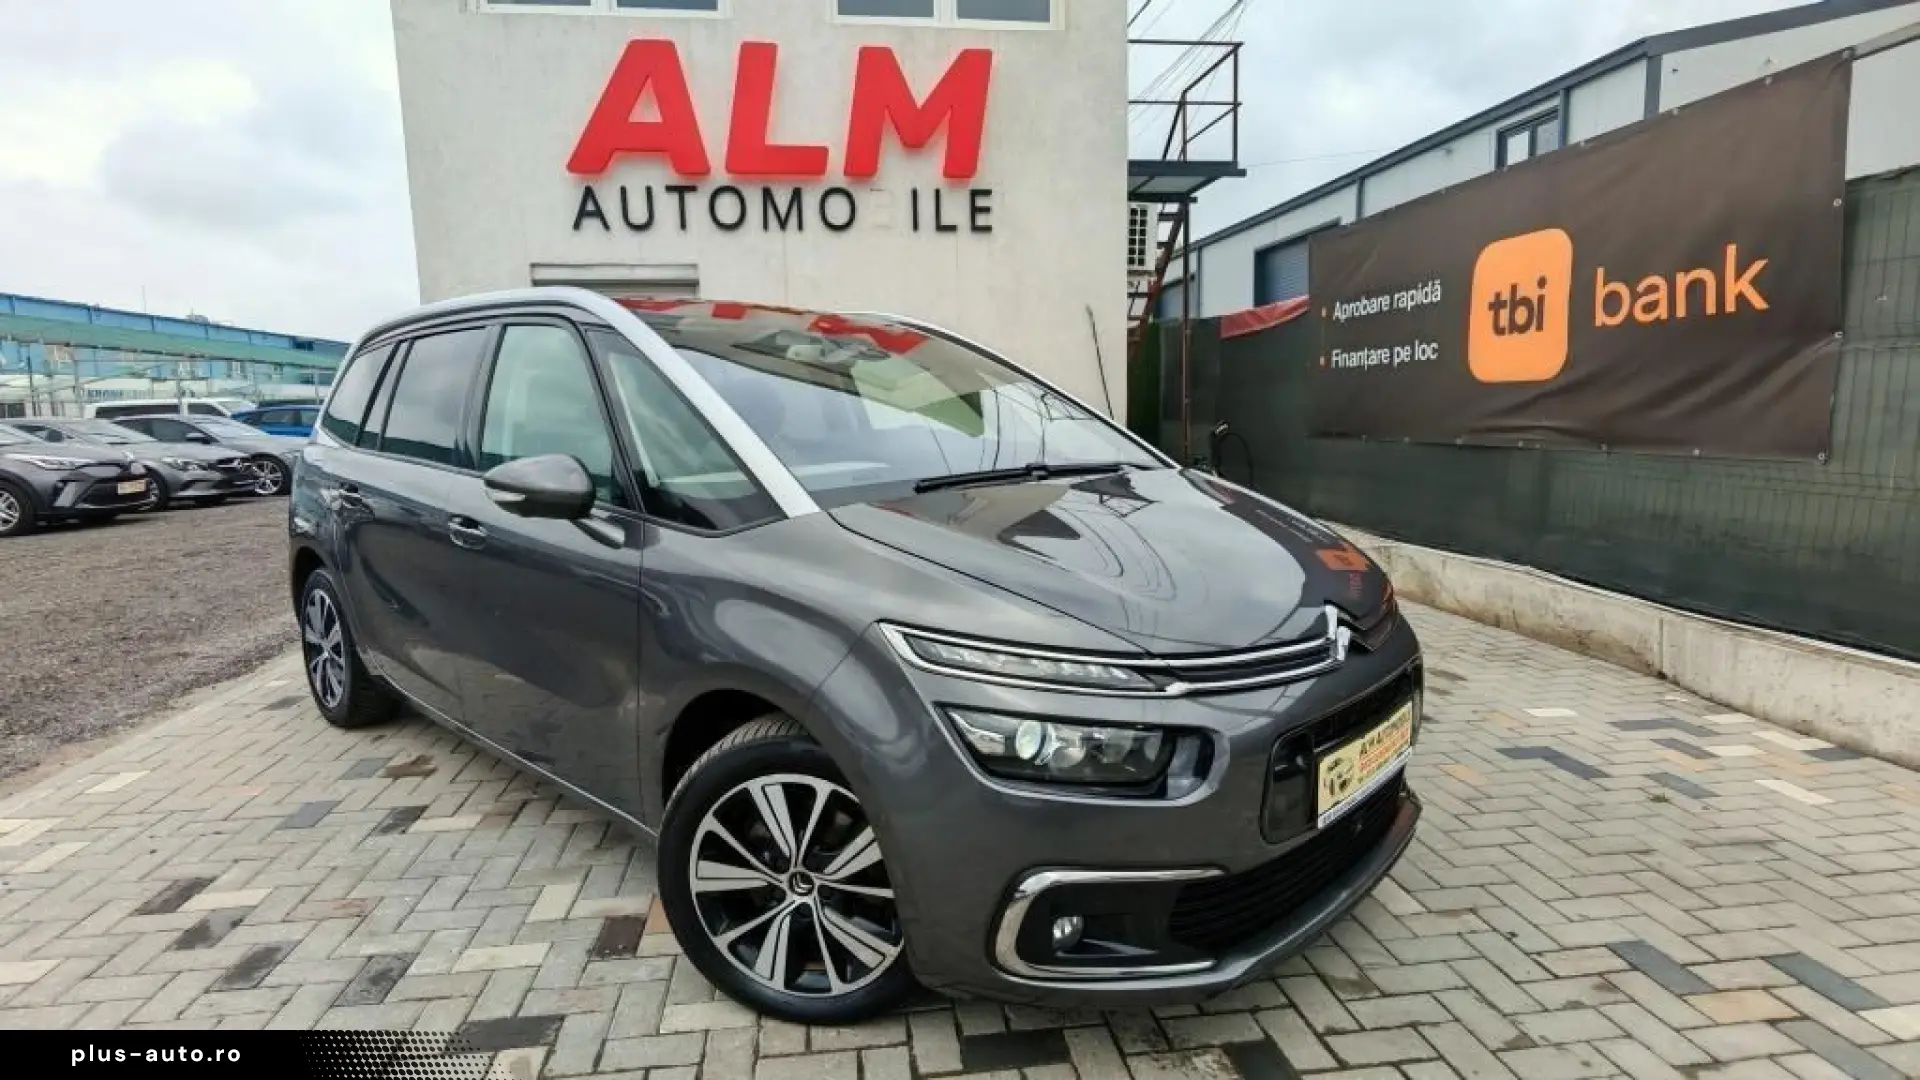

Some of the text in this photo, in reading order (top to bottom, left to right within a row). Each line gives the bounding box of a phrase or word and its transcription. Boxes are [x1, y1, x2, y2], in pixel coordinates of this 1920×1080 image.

[567, 38, 992, 180] ALM
[1332, 279, 1441, 323] Aprobare rapidă
[1487, 242, 1769, 336] tbi bank
[1392, 345, 1412, 368] pe
[1414, 339, 1439, 361] loc
